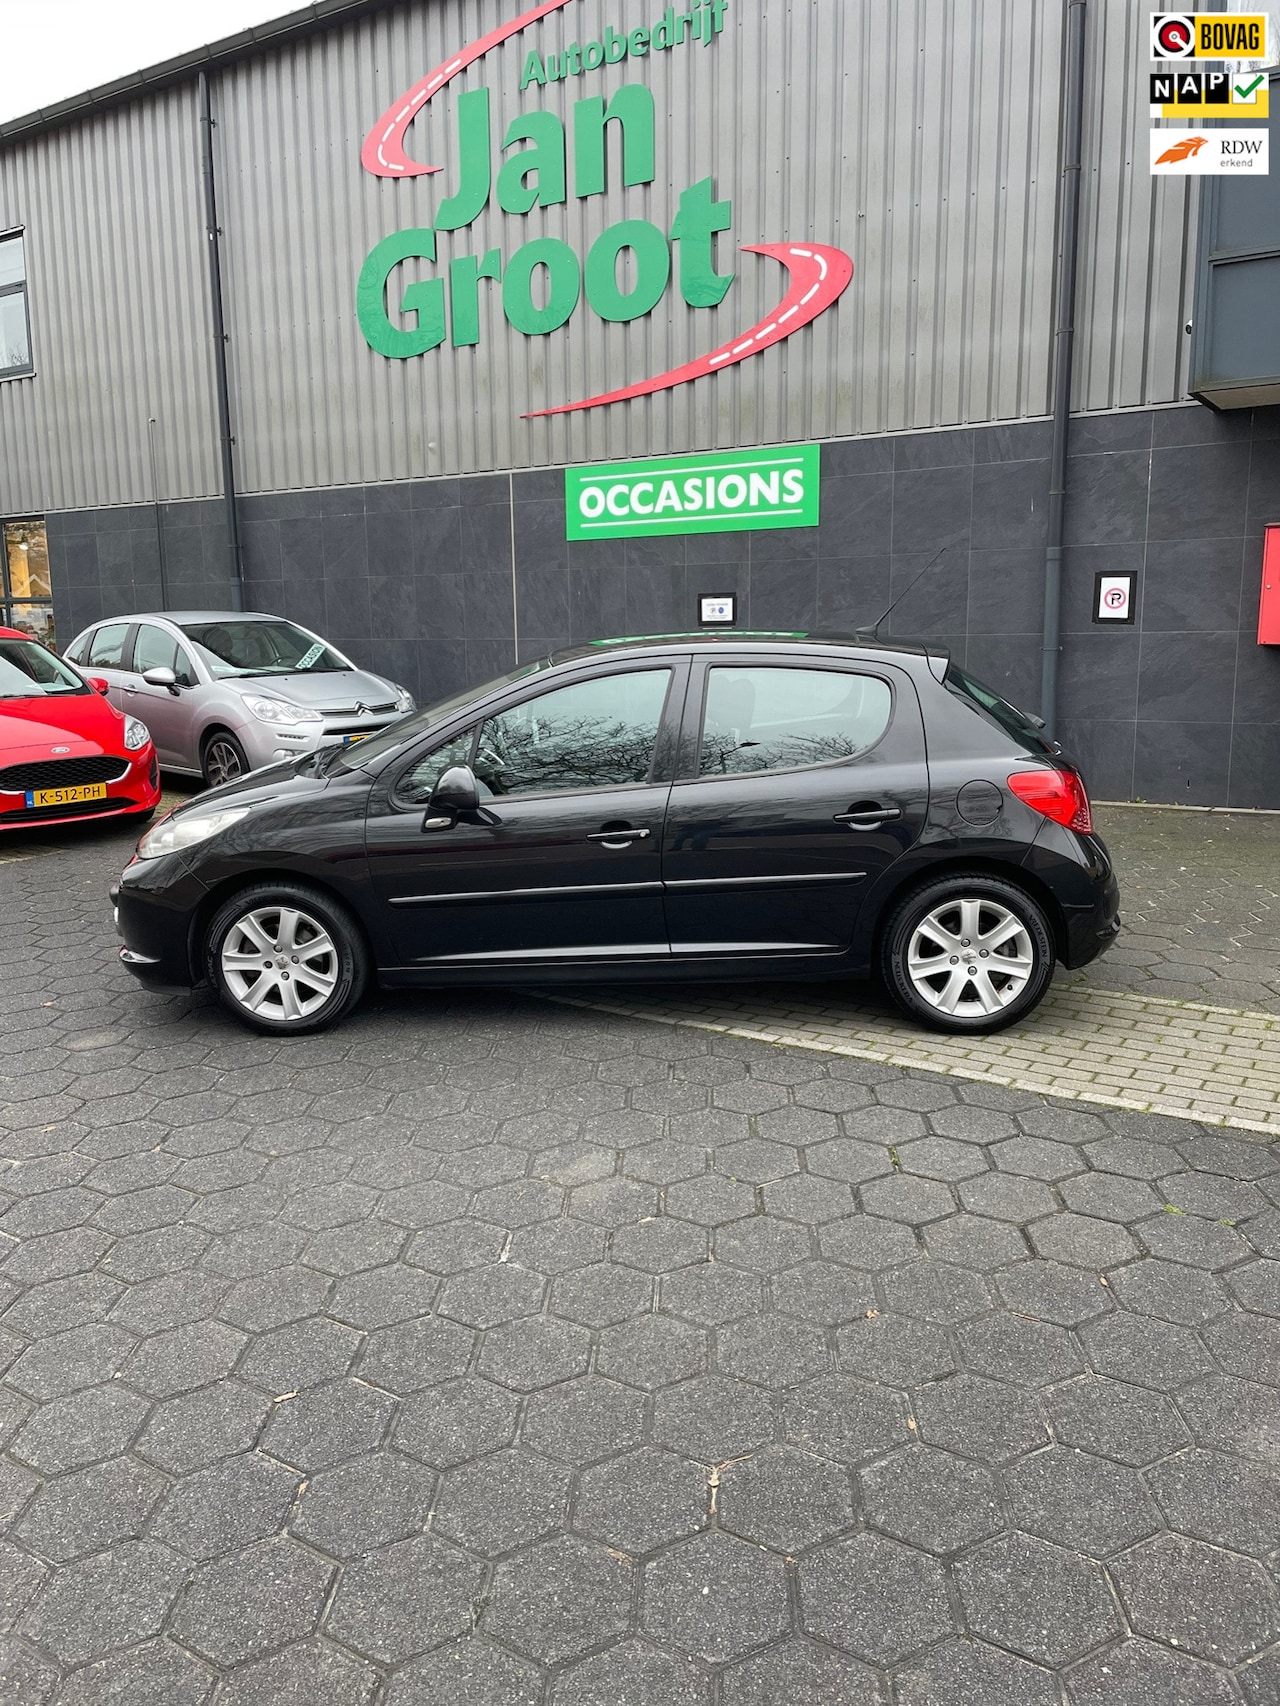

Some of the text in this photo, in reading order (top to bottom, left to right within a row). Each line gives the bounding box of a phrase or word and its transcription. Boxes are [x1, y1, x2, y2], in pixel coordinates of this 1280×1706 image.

[520, 0, 728, 90] Autobedrijf
[433, 83, 655, 231] Jan
[356, 175, 736, 359] Groot
[579, 469, 804, 518] OCCASIONS
[40, 786, 100, 803] K-512-PH
